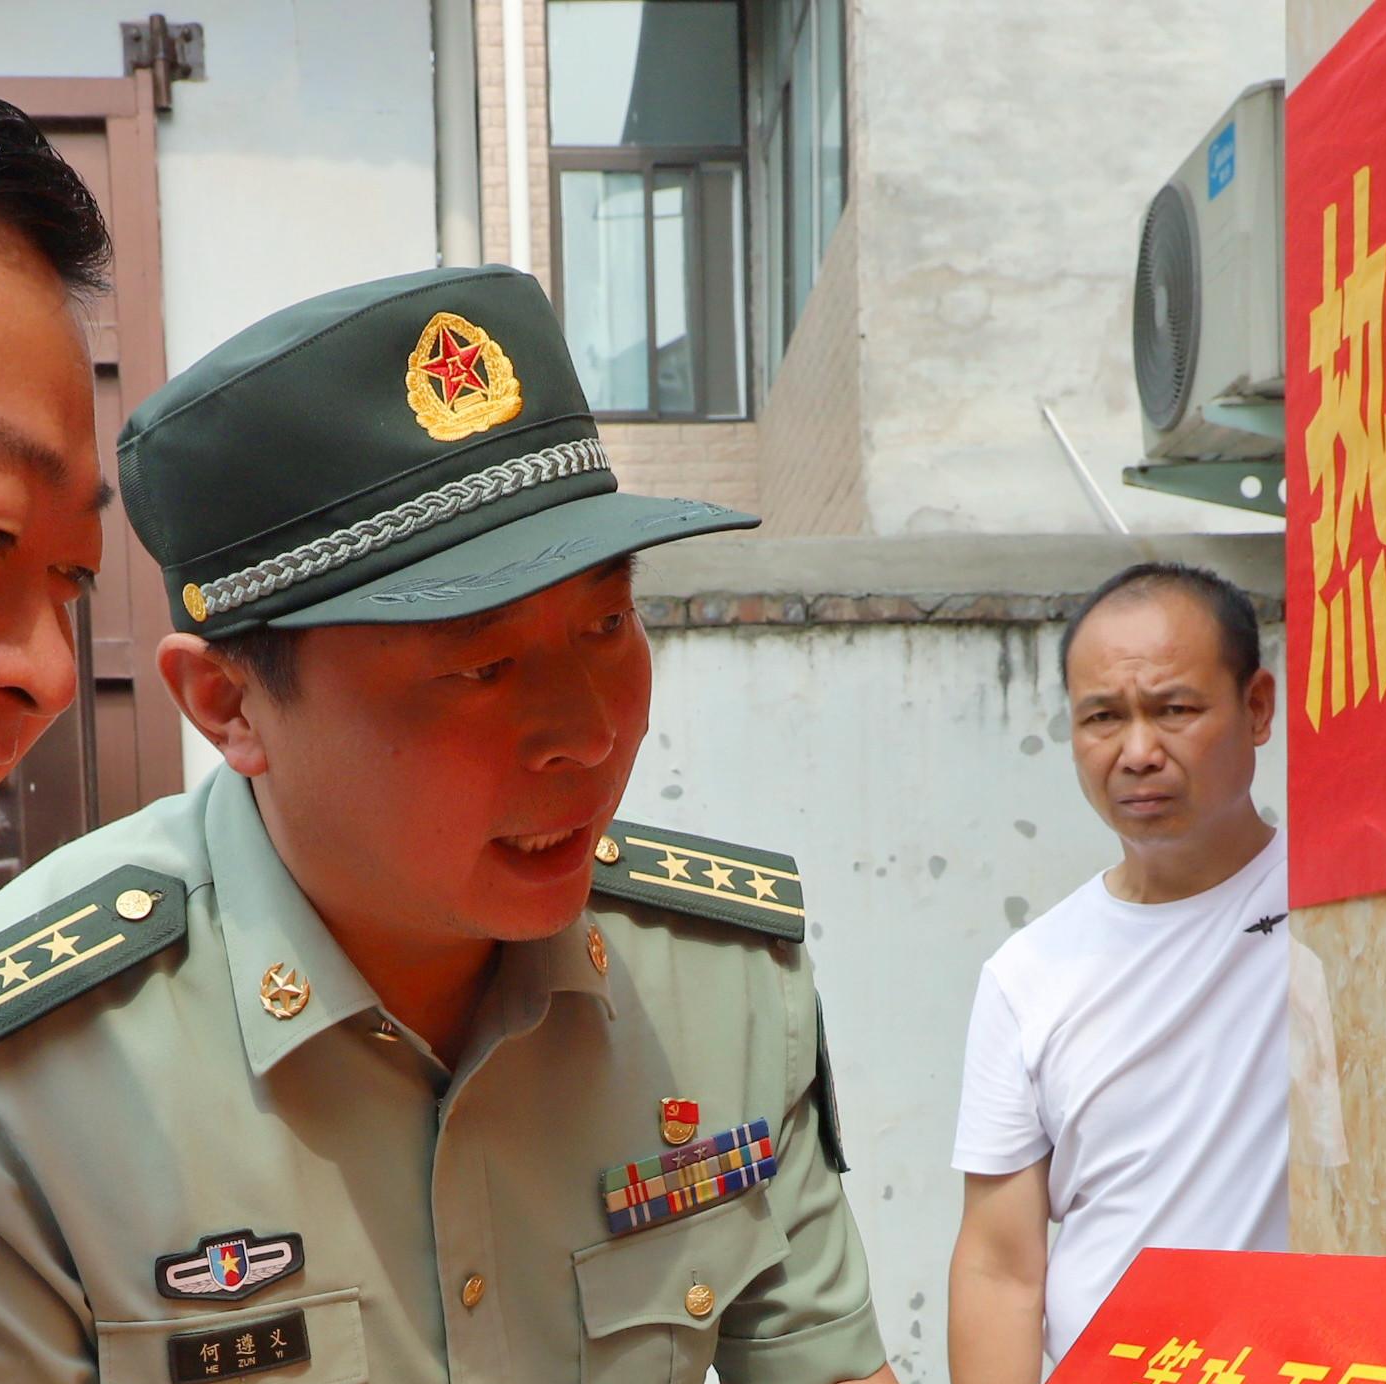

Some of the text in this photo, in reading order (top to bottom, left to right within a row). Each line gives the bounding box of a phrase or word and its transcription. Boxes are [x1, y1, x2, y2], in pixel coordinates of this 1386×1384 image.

[200, 1328, 287, 1362] 何遵义
[205, 1350, 284, 1374] HE ZUN YI
